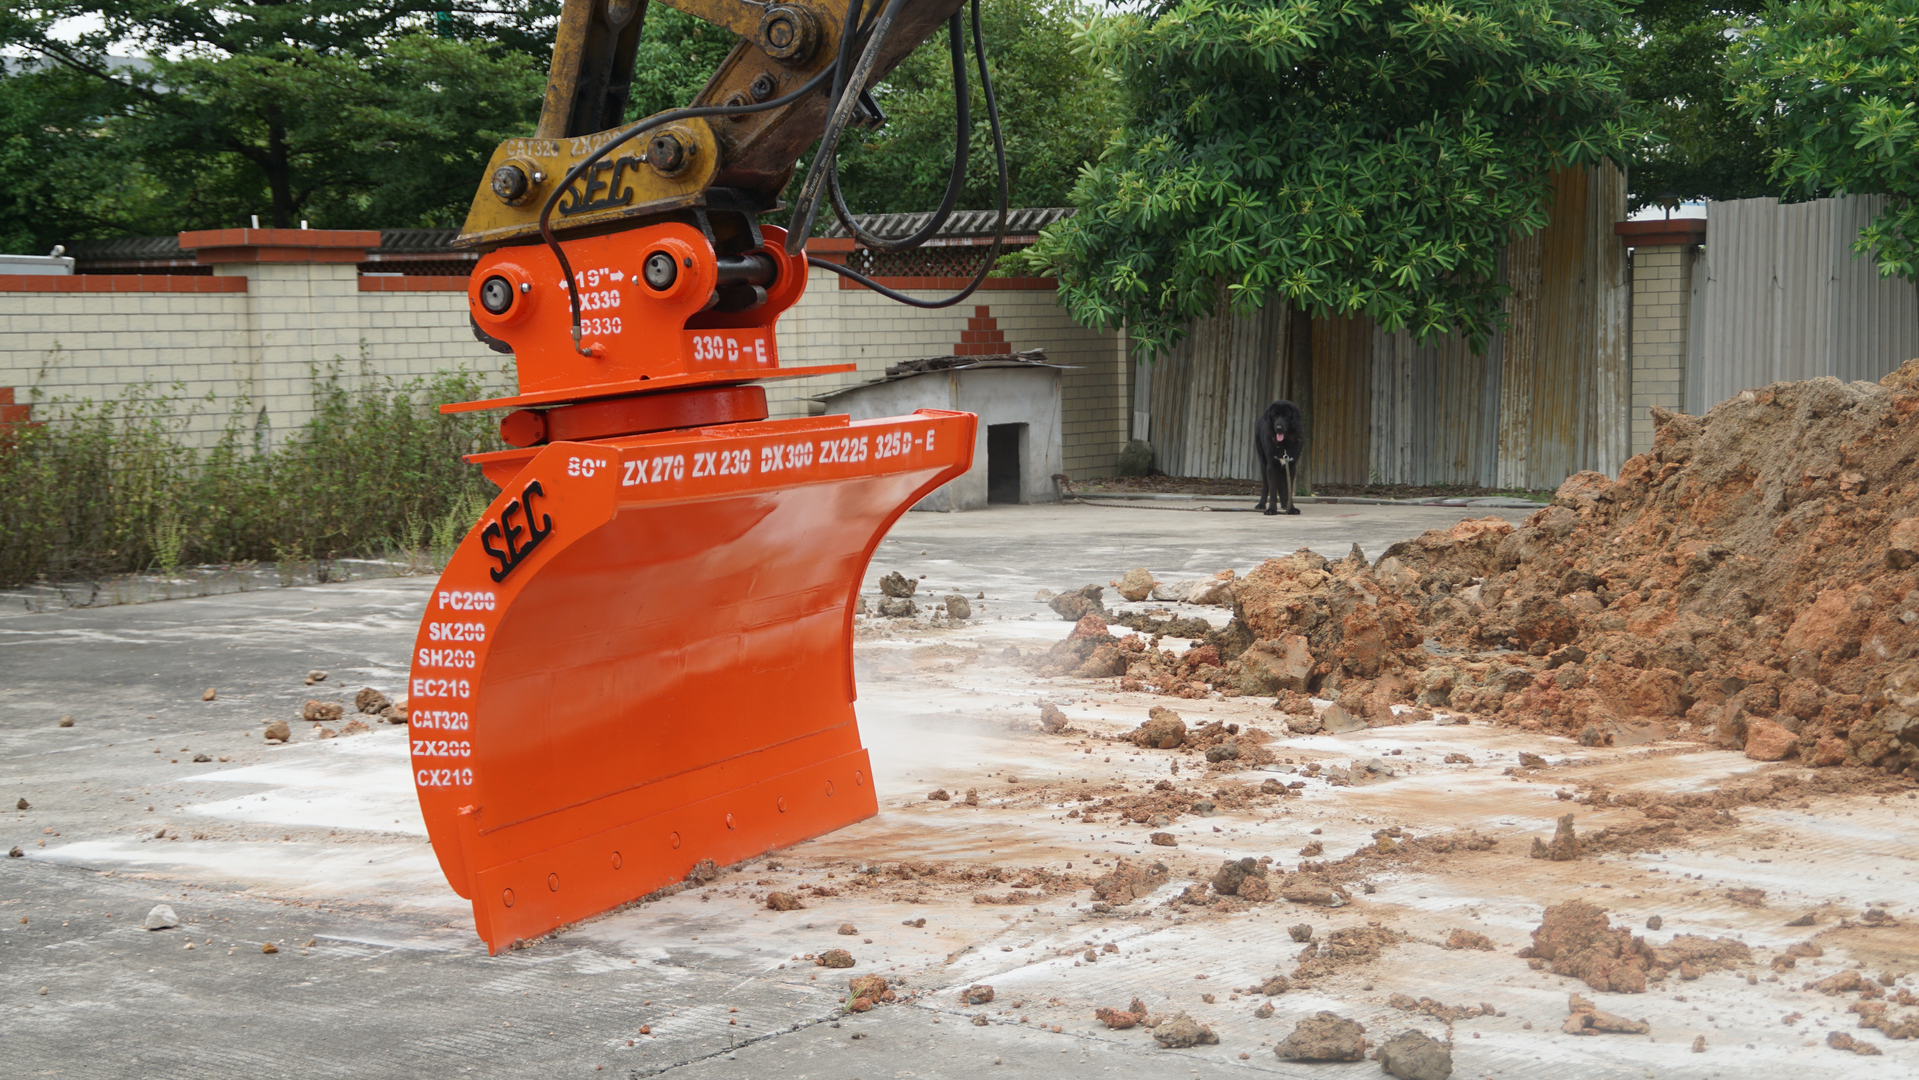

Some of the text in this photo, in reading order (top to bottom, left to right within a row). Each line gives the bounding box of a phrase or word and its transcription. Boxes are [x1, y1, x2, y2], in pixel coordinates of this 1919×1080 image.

[558, 156, 638, 215] SEC
[568, 289, 620, 312] X330
[571, 317, 621, 335] D330
[760, 441, 813, 473] DX300
[818, 436, 868, 463] ZX225
[567, 456, 606, 477] 80"
[481, 479, 552, 583] SEC
[438, 591, 495, 610] PC200
[429, 622, 485, 641] SK200
[418, 648, 475, 668] SH200
[412, 679, 470, 698] EC210
[412, 710, 468, 730] CAT320
[412, 740, 471, 757] ZX200
[417, 768, 472, 786] CX210
